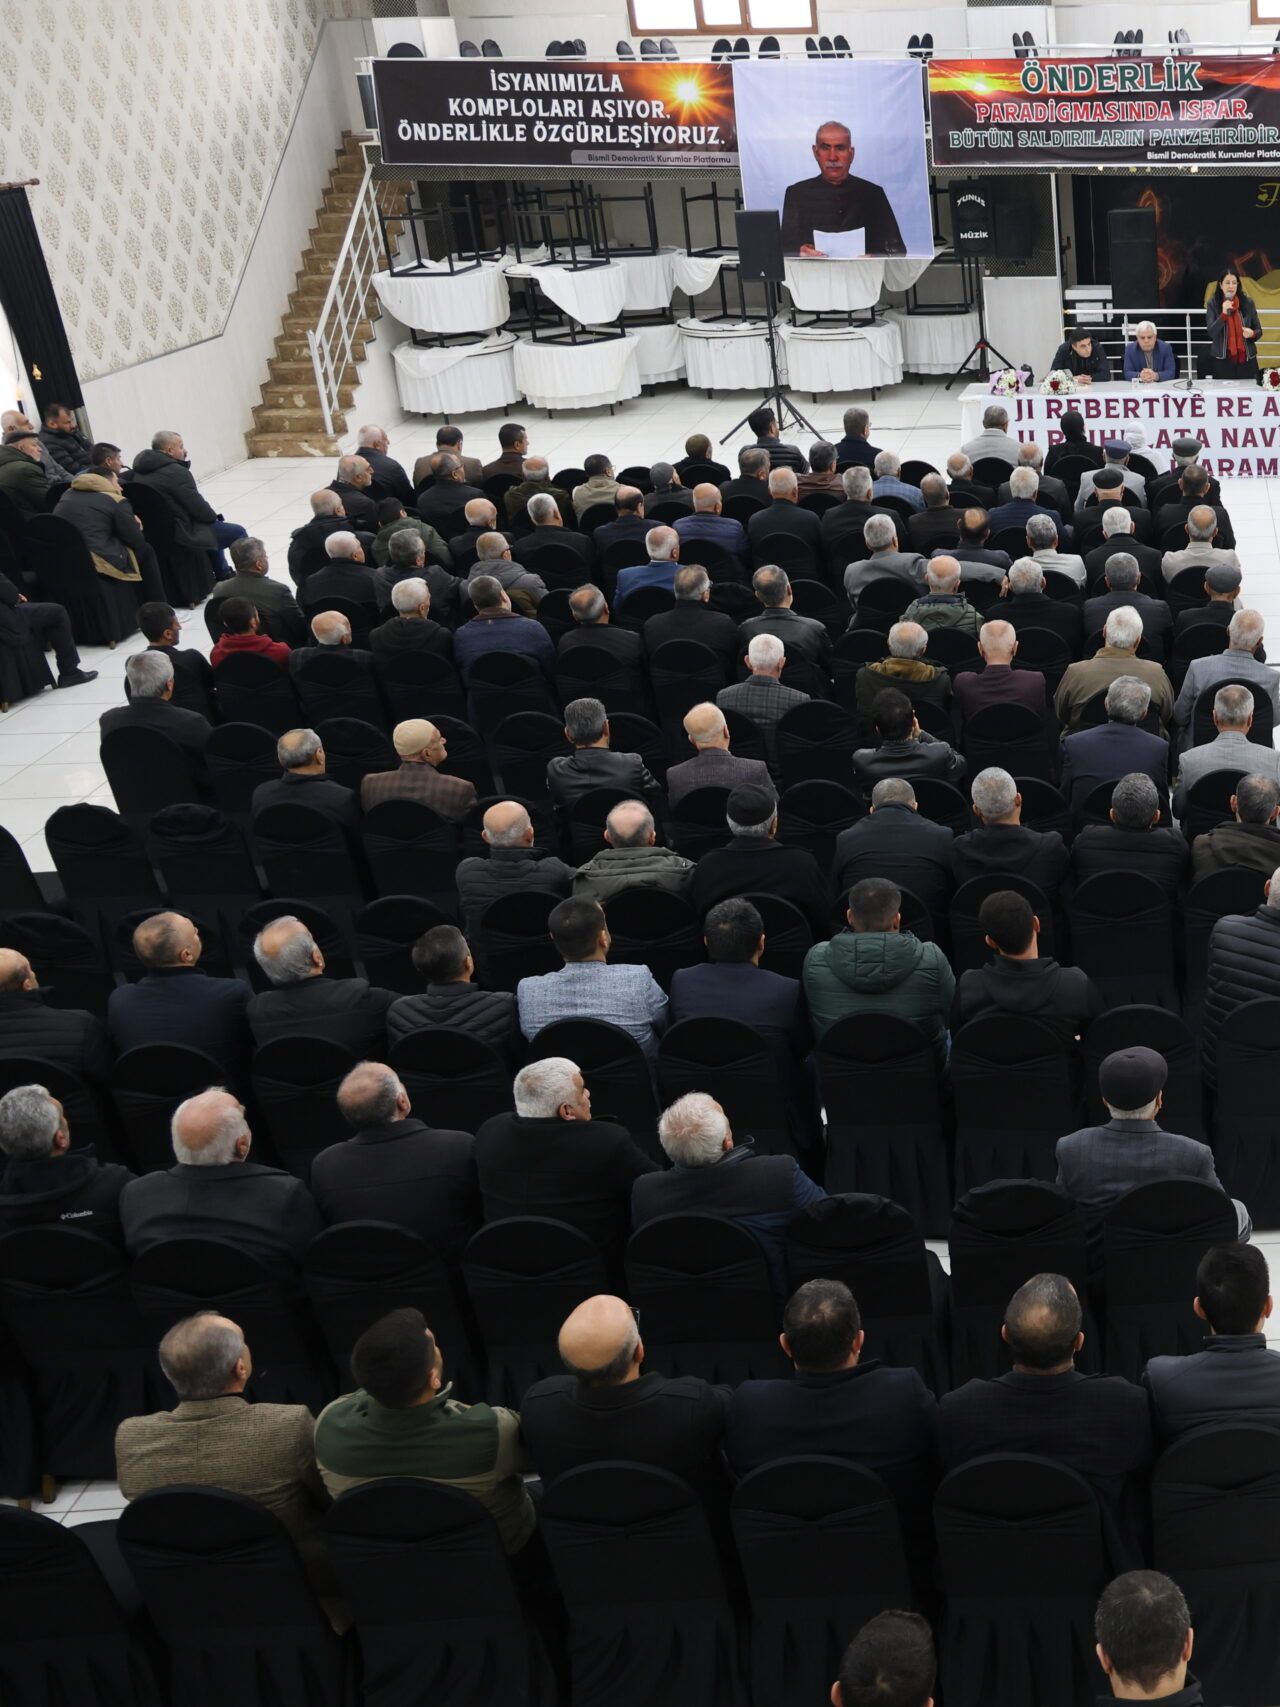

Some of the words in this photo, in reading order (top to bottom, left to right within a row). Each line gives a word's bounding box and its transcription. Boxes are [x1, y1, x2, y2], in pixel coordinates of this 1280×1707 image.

[490, 69, 624, 92] İSYANIMIZLA
[1020, 56, 1203, 93] ÖNDERLİK
[448, 98, 584, 118] KOMPLOLARI
[591, 99, 671, 122] AŞIYOR.
[975, 99, 1174, 123] PARADİGMASINDA
[1179, 98, 1253, 121] ISRAR.
[398, 119, 527, 142] ÖNDERLİKLE
[533, 121, 725, 148] ÖZGÜRLEŞİYORUZ.
[949, 127, 1013, 148] BÜTÜN
[1017, 129, 1144, 148] SALDIRILARIN
[588, 153, 610, 162] Bismil
[611, 154, 655, 162] Demokratik
[657, 154, 691, 163] Kurumlar
[693, 155, 731, 163] Platformu
[1147, 152, 1169, 160] Bismil
[1171, 151, 1217, 160] Demokratik
[1218, 151, 1255, 159] Kurumlar
[957, 194, 986, 207] YUNUS
[1015, 399, 1034, 422] JI
[1216, 396, 1253, 417] RE
